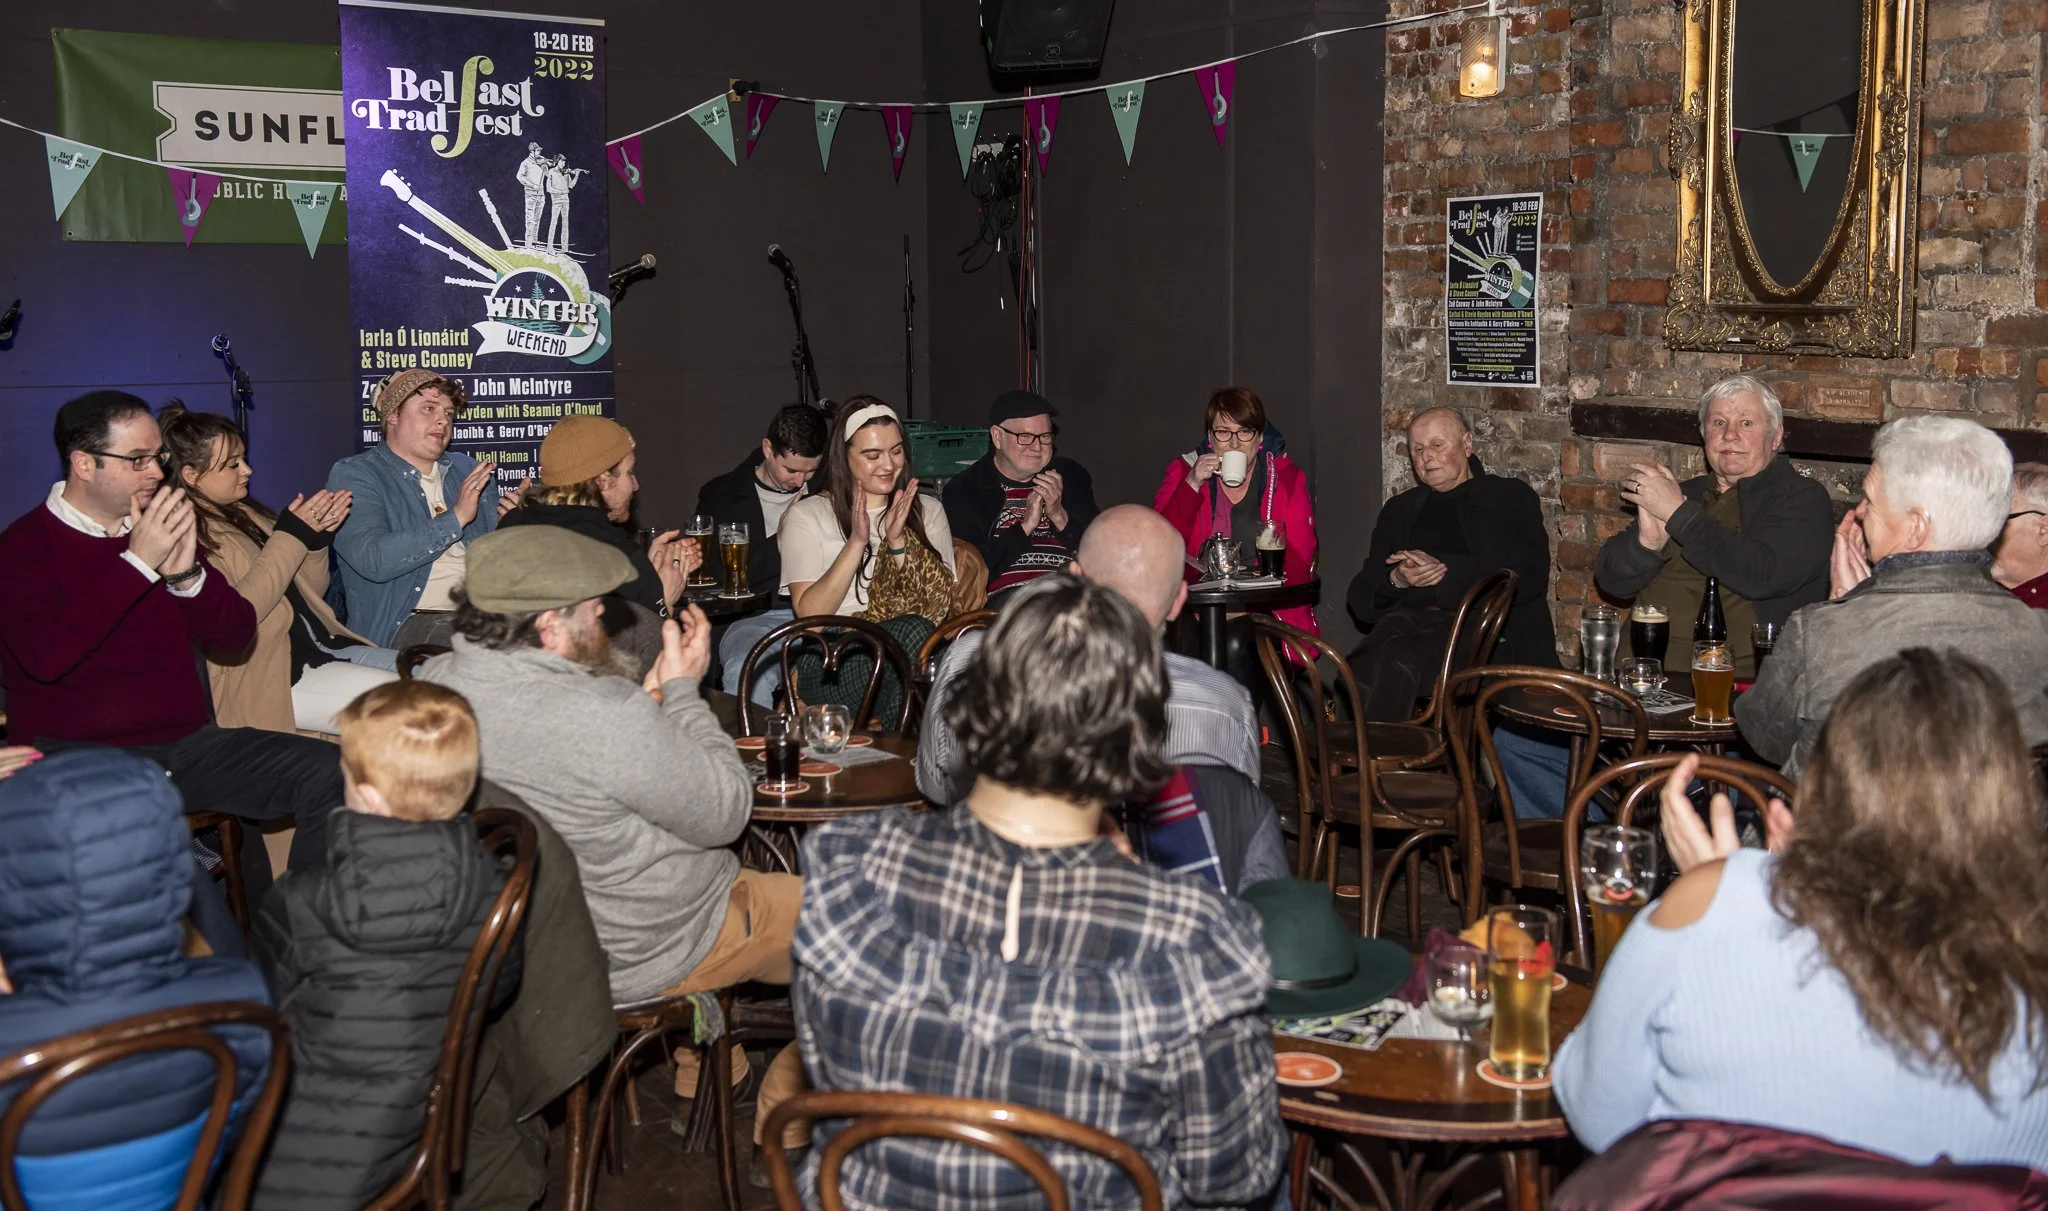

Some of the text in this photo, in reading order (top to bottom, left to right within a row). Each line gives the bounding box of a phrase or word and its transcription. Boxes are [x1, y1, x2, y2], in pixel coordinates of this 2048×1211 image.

[533, 31, 594, 52] 18-20 FEB
[534, 56, 594, 81] 2022
[387, 55, 545, 117] Belfast
[194, 110, 345, 146] SUNFL
[1512, 200, 1539, 211] 18-20 FEB
[1512, 214, 1537, 226] 2022
[1484, 273, 1514, 290] WINTER
[483, 294, 599, 325] WINTER
[359, 325, 469, 348] Iarla Ó Lionáird
[507, 328, 567, 356] WEEKEND
[361, 350, 474, 370] & Steve Cooney
[472, 378, 505, 397] John
[510, 378, 572, 397] McIntyre
[496, 404, 520, 418] with
[522, 403, 561, 417] Seamie
[565, 402, 602, 416] O'Dowd
[486, 426, 494, 438] &
[499, 426, 525, 439] Gerry
[528, 424, 552, 437] O'Bei
[475, 450, 529, 463] Niall Hanna
[497, 467, 527, 481] Rynne
[529, 466, 536, 479] &
